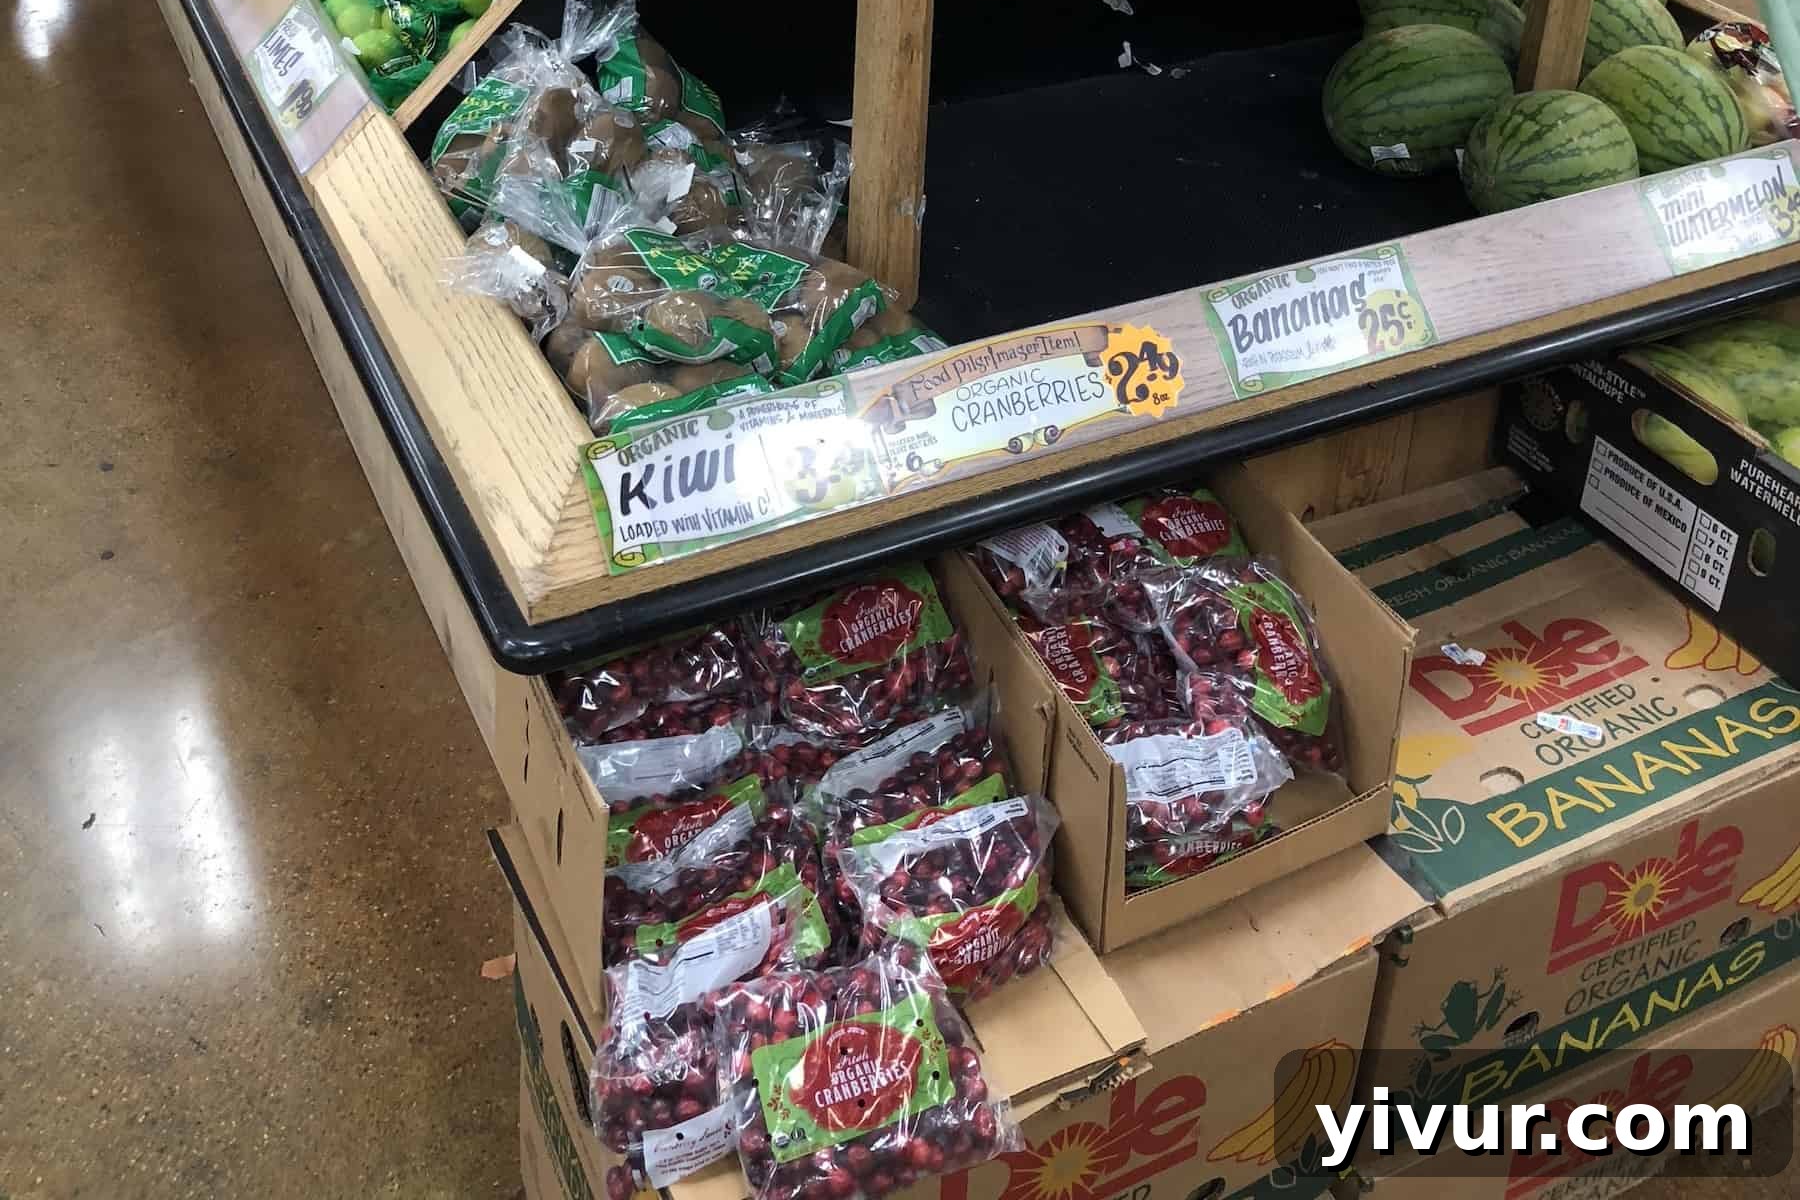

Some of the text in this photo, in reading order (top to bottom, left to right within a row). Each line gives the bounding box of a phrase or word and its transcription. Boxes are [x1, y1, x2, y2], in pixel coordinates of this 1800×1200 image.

[263, 30, 305, 77] LIMES
[1667, 164, 1788, 248] WATERMELON
[1231, 272, 1292, 310] ORGANIC
[911, 371, 951, 401] Food
[951, 370, 1105, 433] CRANBERRIES
[955, 367, 1046, 403] ORGANIC
[616, 419, 700, 468] ORGANIC
[1606, 451, 1646, 485] PRODUCE
[1646, 478, 1659, 492] OF
[1166, 512, 1209, 531] ORGANIC
[1603, 466, 1688, 535] PRODUCE OF MEXICO
[618, 518, 669, 544] LOADED
[1707, 537, 1715, 548] 7
[1433, 554, 1506, 593] ORGANIC
[839, 608, 914, 654] CRANBERRIES
[851, 605, 892, 633] ORGANIC
[1410, 617, 1622, 722] Dole
[1520, 682, 1638, 740] CETIFIED
[1486, 697, 1800, 850] BANANAS
[1547, 817, 1745, 962] Dole
[1580, 919, 1697, 982] CERTIFIED
[1565, 938, 1702, 1016] ORGANIC
[1459, 939, 1768, 1106] BANANAS
[814, 1060, 909, 1108] CRANBERRIES
